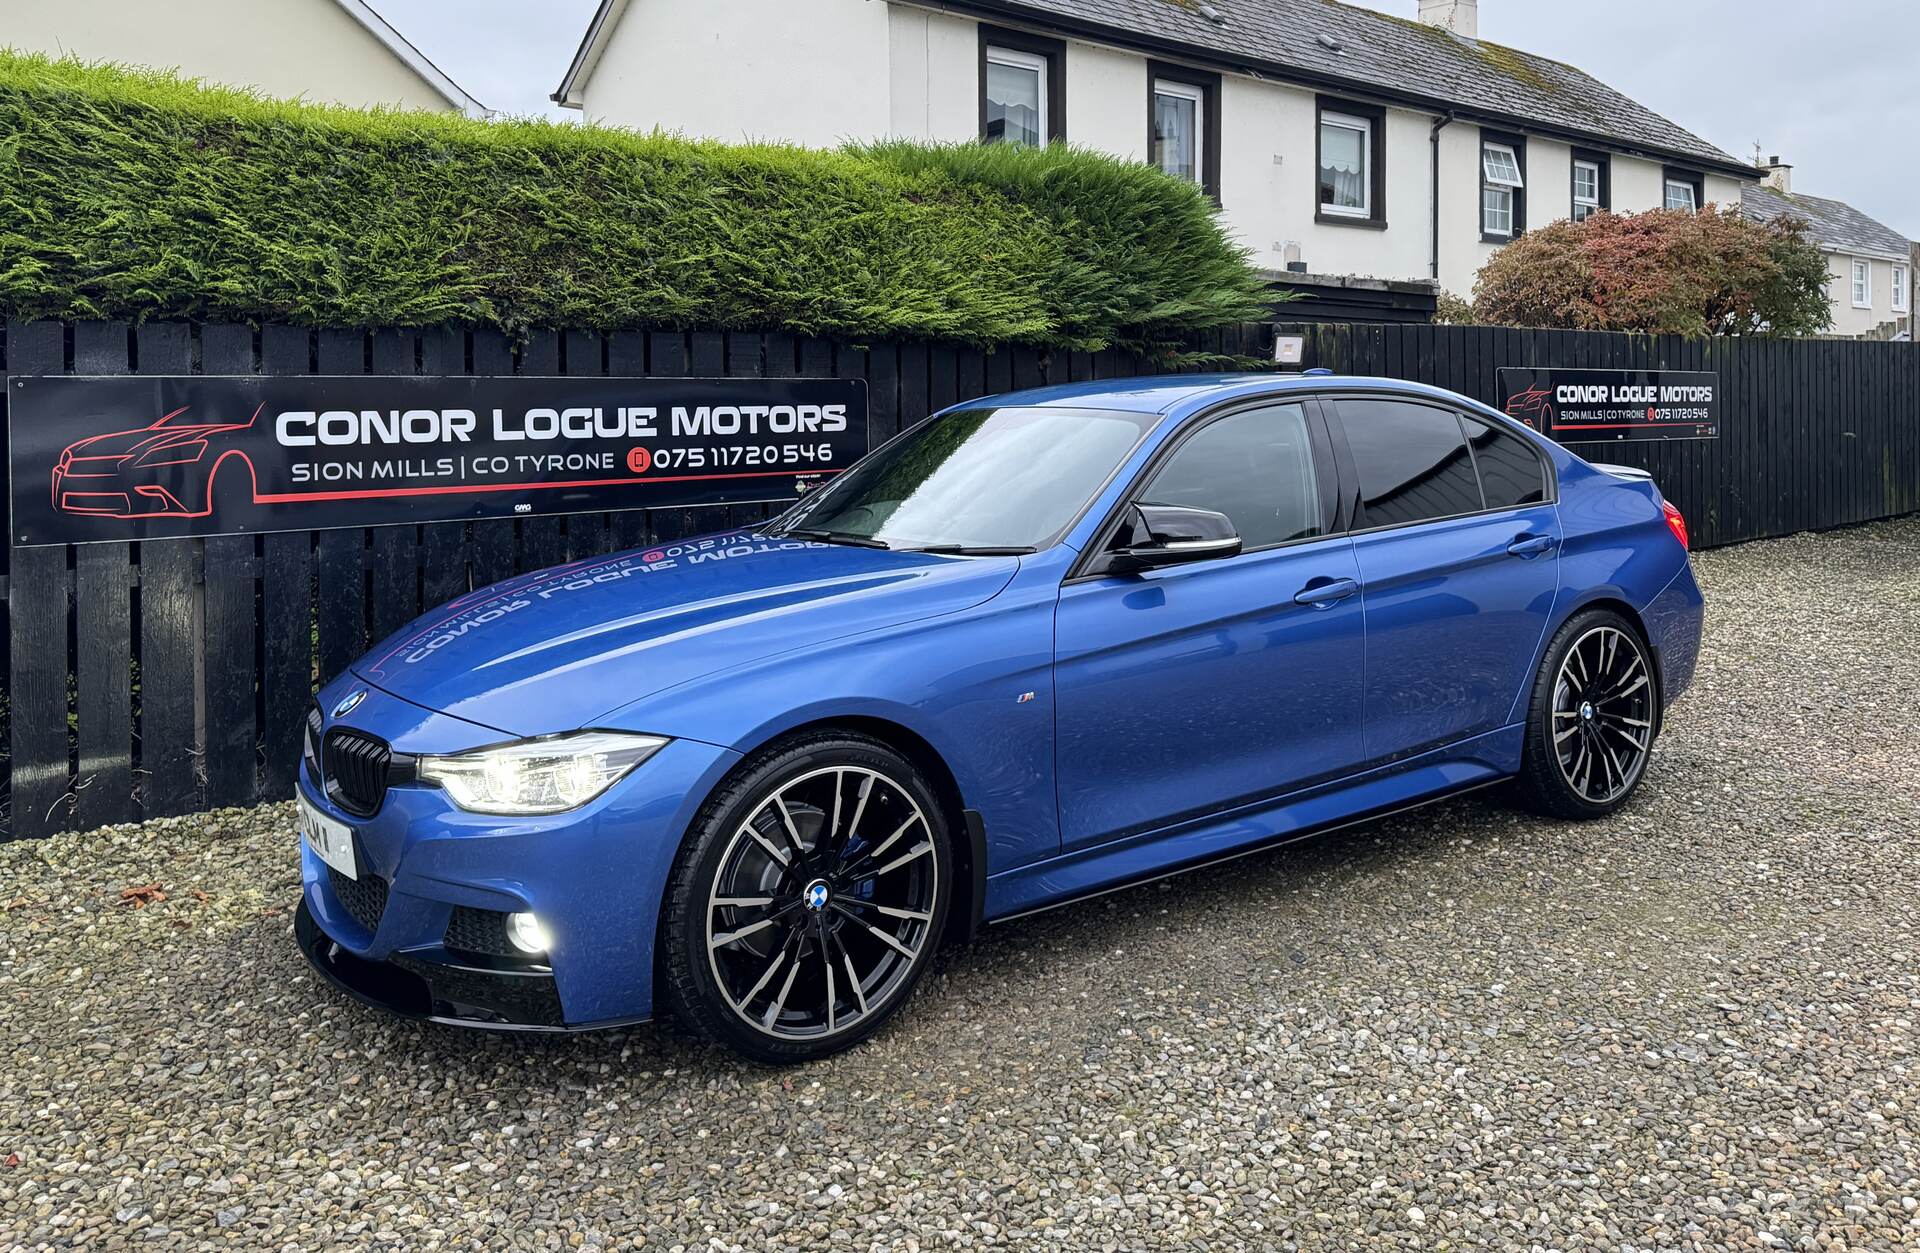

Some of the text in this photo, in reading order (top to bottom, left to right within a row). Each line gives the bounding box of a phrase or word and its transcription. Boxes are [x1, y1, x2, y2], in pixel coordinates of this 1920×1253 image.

[1556, 385, 1713, 403] CONOR LOGUE MOTORS
[275, 404, 847, 447] CONOR LOGUE MOTORS
[1560, 410, 1580, 420] SION
[1581, 410, 1602, 420] MILLS
[291, 461, 363, 482] SION
[370, 458, 454, 479] MILLS
